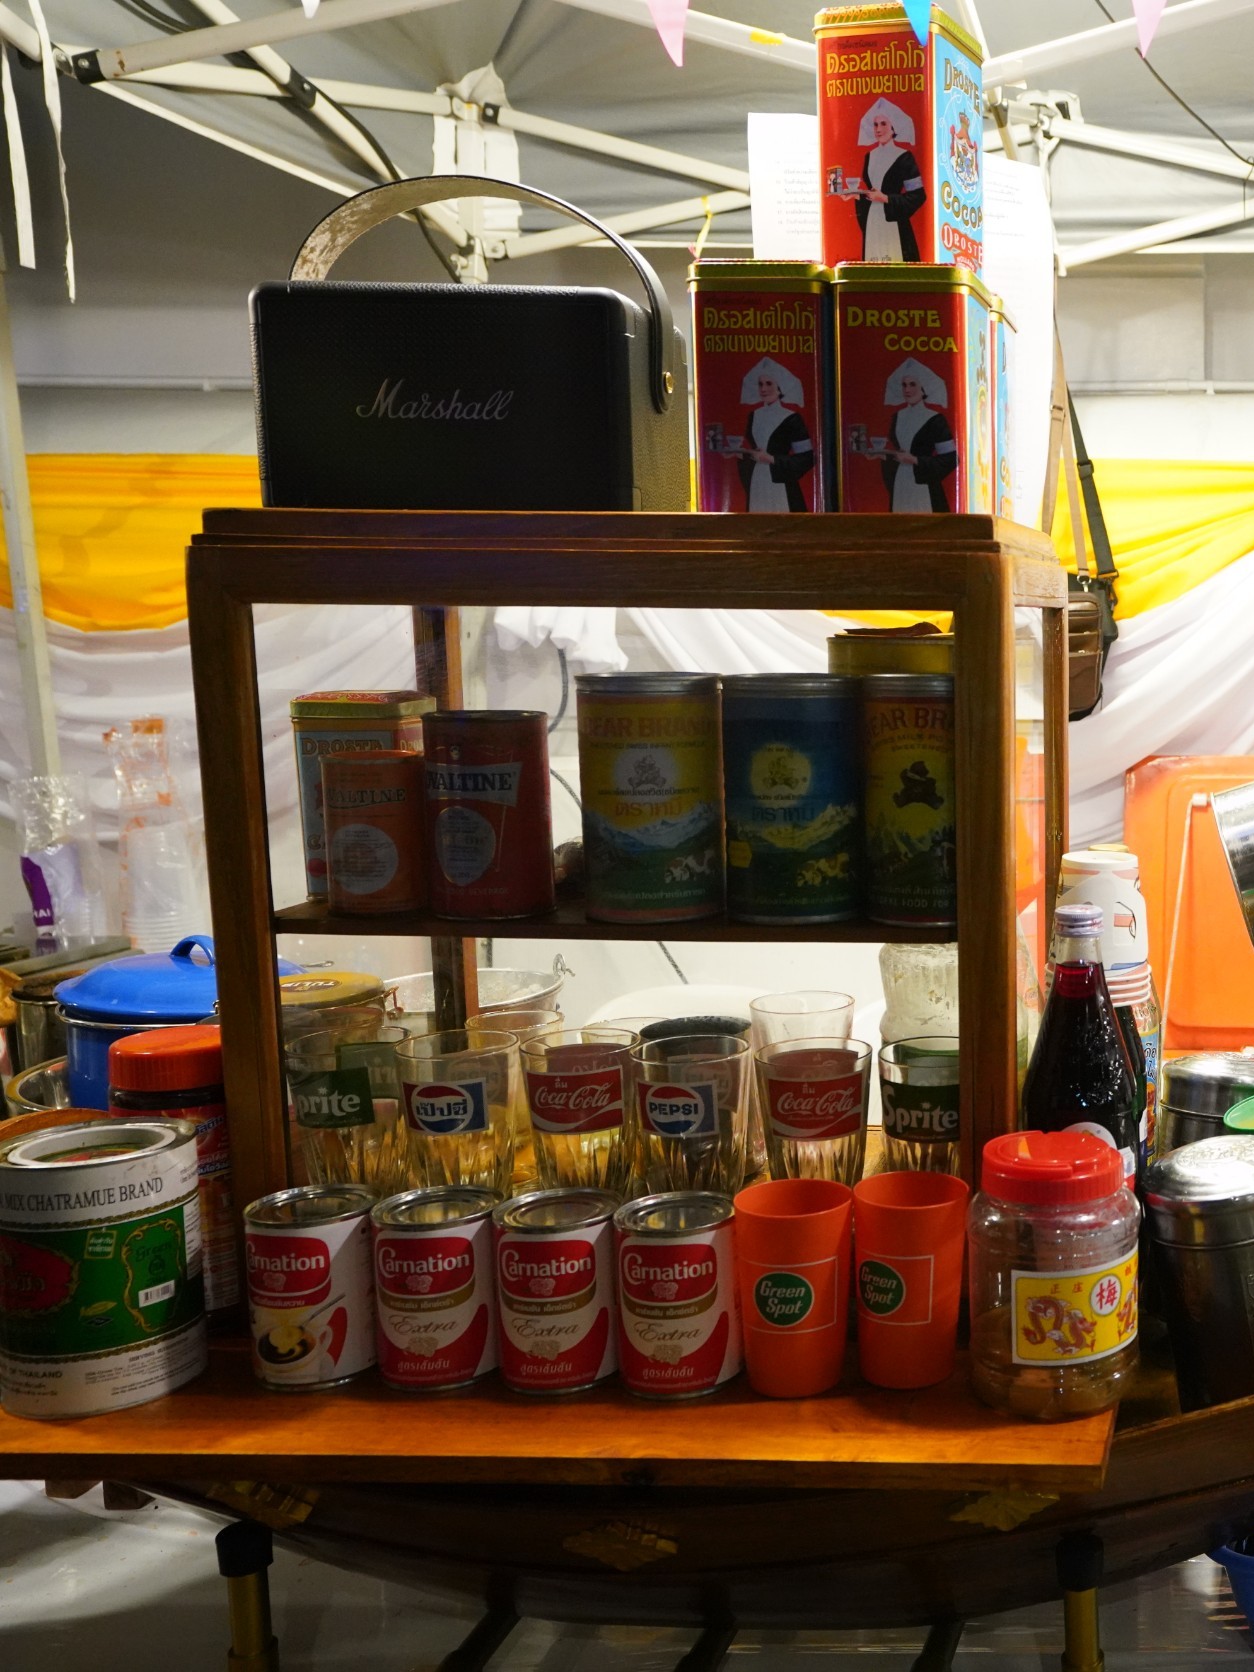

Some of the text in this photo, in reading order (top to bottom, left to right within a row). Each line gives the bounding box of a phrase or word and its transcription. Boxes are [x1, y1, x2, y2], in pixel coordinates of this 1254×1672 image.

[826, 74, 926, 97] ตรานางพยาบาล
[944, 58, 981, 113] DROSTE
[703, 301, 815, 330] ดรอสเต้โกโก้
[847, 306, 942, 328] DROSTE
[703, 333, 815, 353] ตรานางพยาบาล
[884, 333, 958, 353] COCOA
[356, 378, 514, 420] Marshall
[296, 1088, 360, 1119] prite
[535, 1080, 614, 1110] Coca-Cola
[649, 1102, 699, 1115] PEPSI
[777, 1086, 856, 1115] Coca-Cola
[883, 1085, 959, 1133] Sprite
[3, 1177, 163, 1212] MIX CHATRAMUE BRAND
[246, 1241, 325, 1273] Carnation
[380, 1247, 469, 1278] Carnation
[501, 1249, 591, 1281] Carnation
[623, 1253, 713, 1285] Carnation
[760, 1281, 806, 1298] Green
[861, 1266, 897, 1289] Green
[766, 1298, 803, 1318] Spot
[864, 1284, 895, 1305] Spot
[1096, 1279, 1117, 1310] 梅
[389, 1315, 456, 1334] Extra
[511, 1317, 579, 1338] Extra
[633, 1321, 700, 1341] Extra
